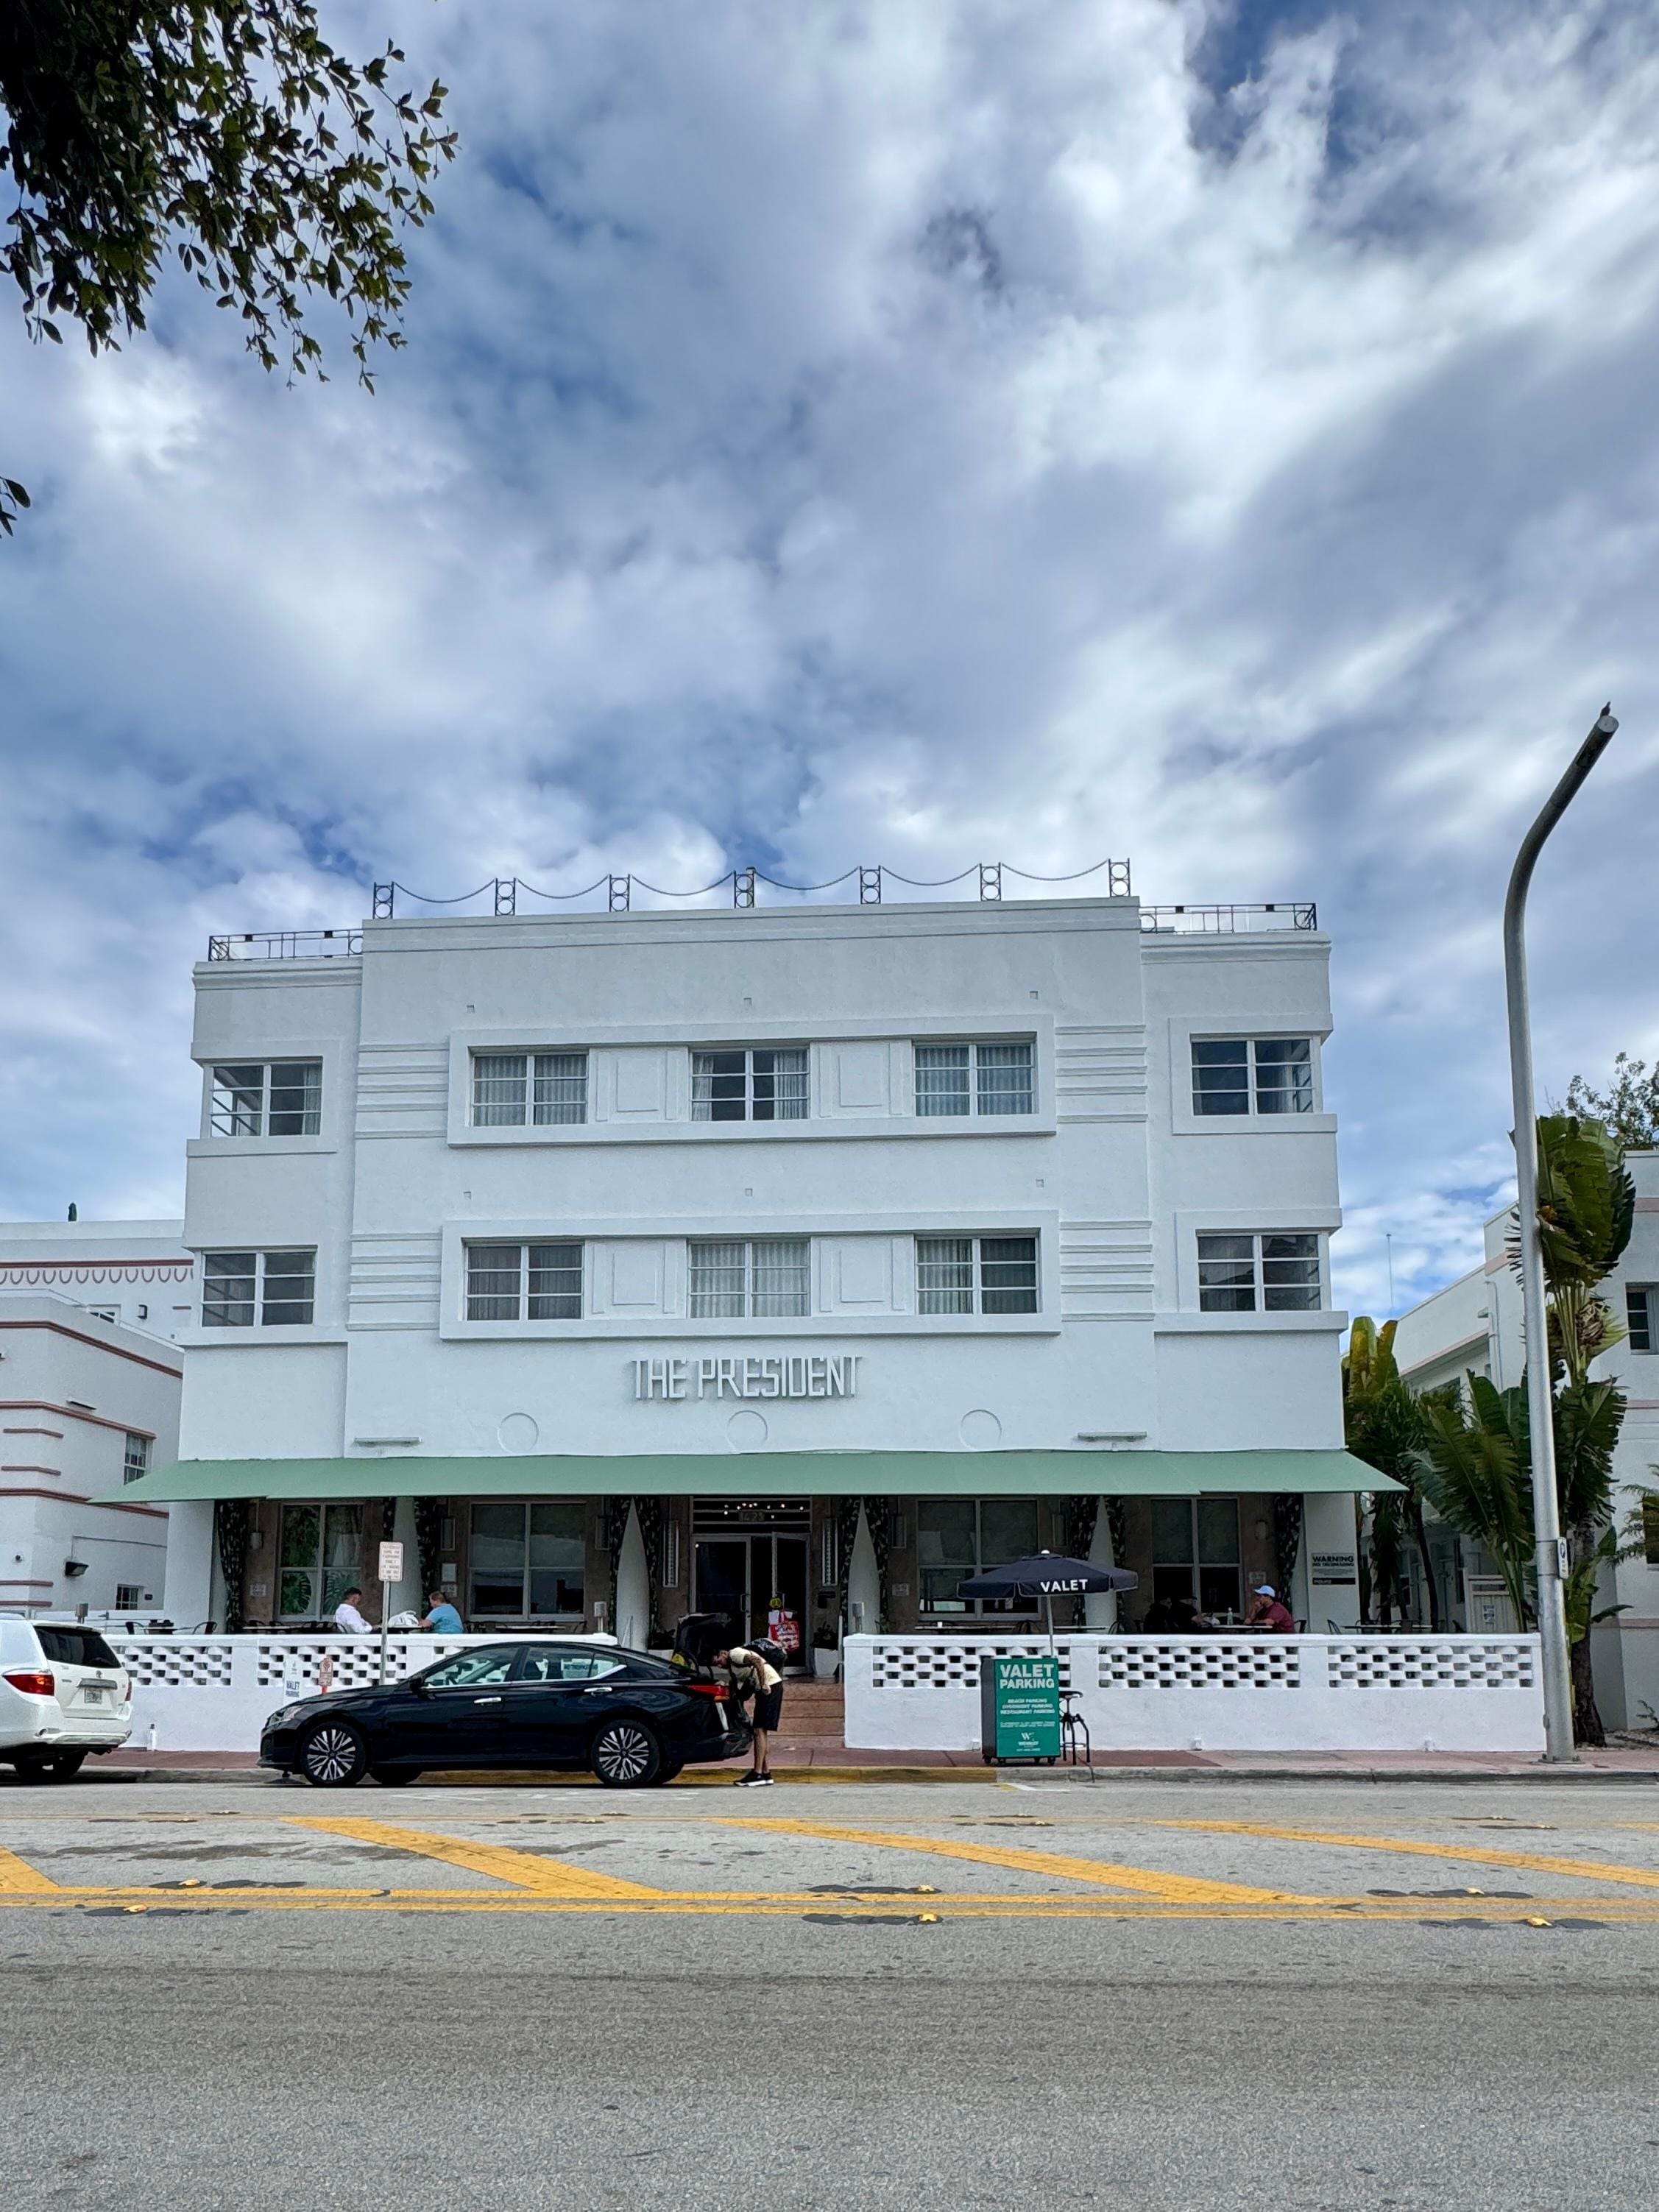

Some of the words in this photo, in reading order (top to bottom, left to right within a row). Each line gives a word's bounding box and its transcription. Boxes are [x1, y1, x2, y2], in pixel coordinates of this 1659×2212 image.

[629, 1358, 686, 1399] THE
[697, 1355, 863, 1398] PRESIDENT
[1040, 1579, 1089, 1592] VALET
[1000, 1664, 1055, 1678] VALET
[1000, 1678, 1055, 1689] PARKING
